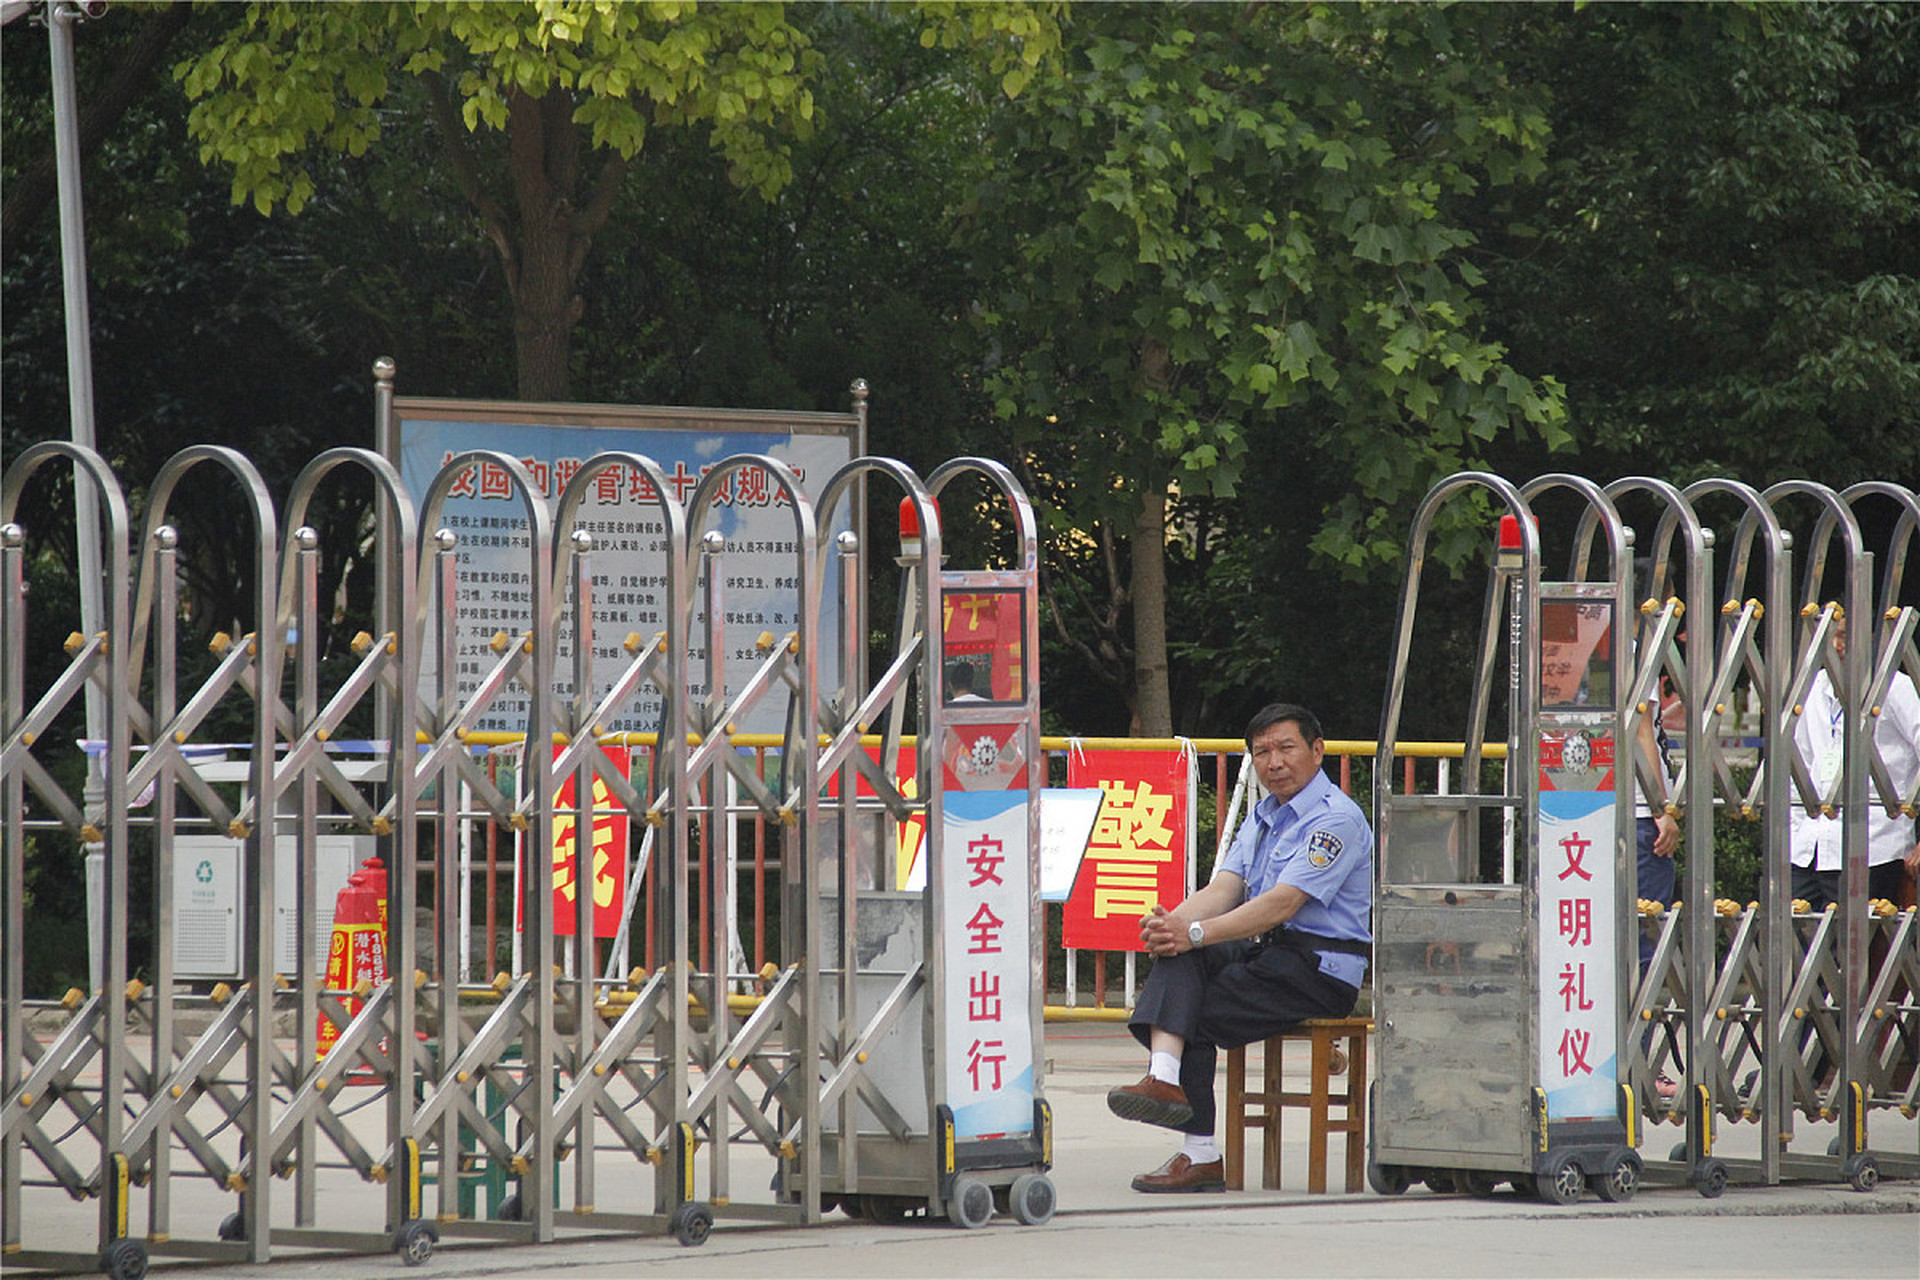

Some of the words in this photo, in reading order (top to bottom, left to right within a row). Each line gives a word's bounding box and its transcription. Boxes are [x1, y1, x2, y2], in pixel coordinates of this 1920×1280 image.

[966, 833, 1006, 1091] 安全出行
[1085, 780, 1174, 919] 警
[1558, 832, 1593, 1077] 文明礼仪
